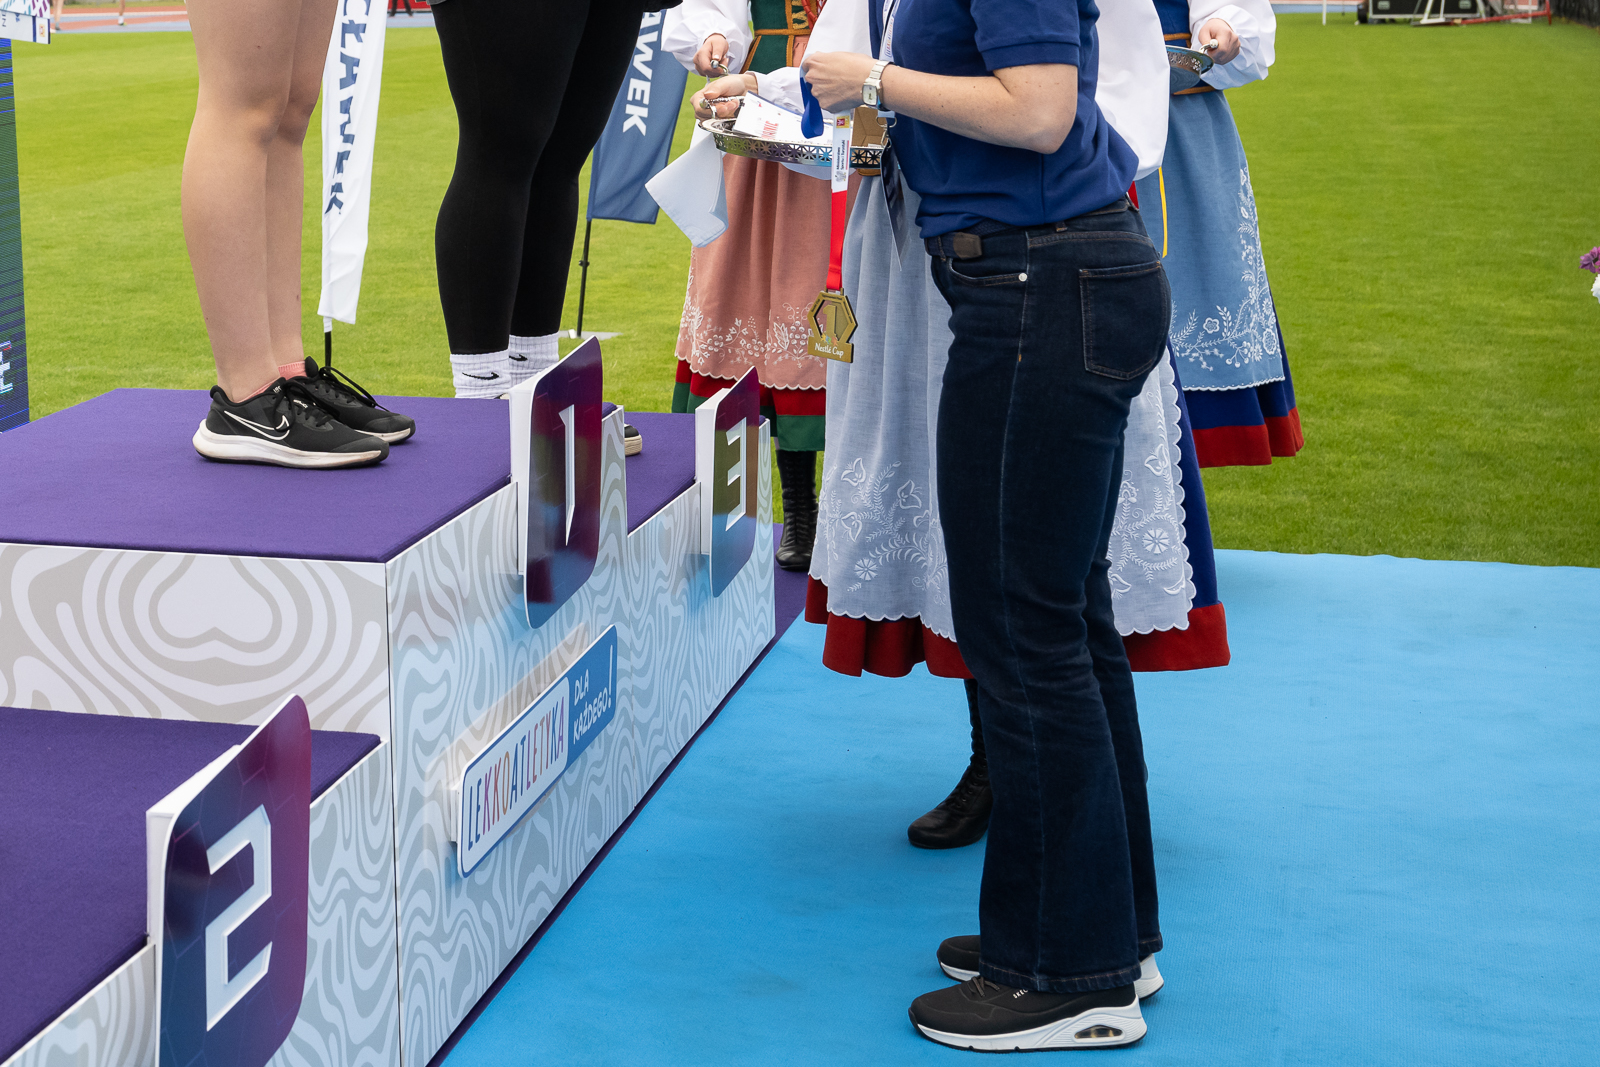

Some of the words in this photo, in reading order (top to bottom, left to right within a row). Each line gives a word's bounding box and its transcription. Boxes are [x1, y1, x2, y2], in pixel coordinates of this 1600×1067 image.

[622, 12, 662, 137] AWEK
[814, 342, 832, 354] Nestlé
[832, 346, 845, 358] Cup
[725, 417, 748, 532] 3
[572, 644, 614, 745] KAŻDEGO!
[573, 669, 590, 706] DLA
[467, 696, 565, 851] LEKKOATLETYKA
[204, 803, 273, 1032] 2
